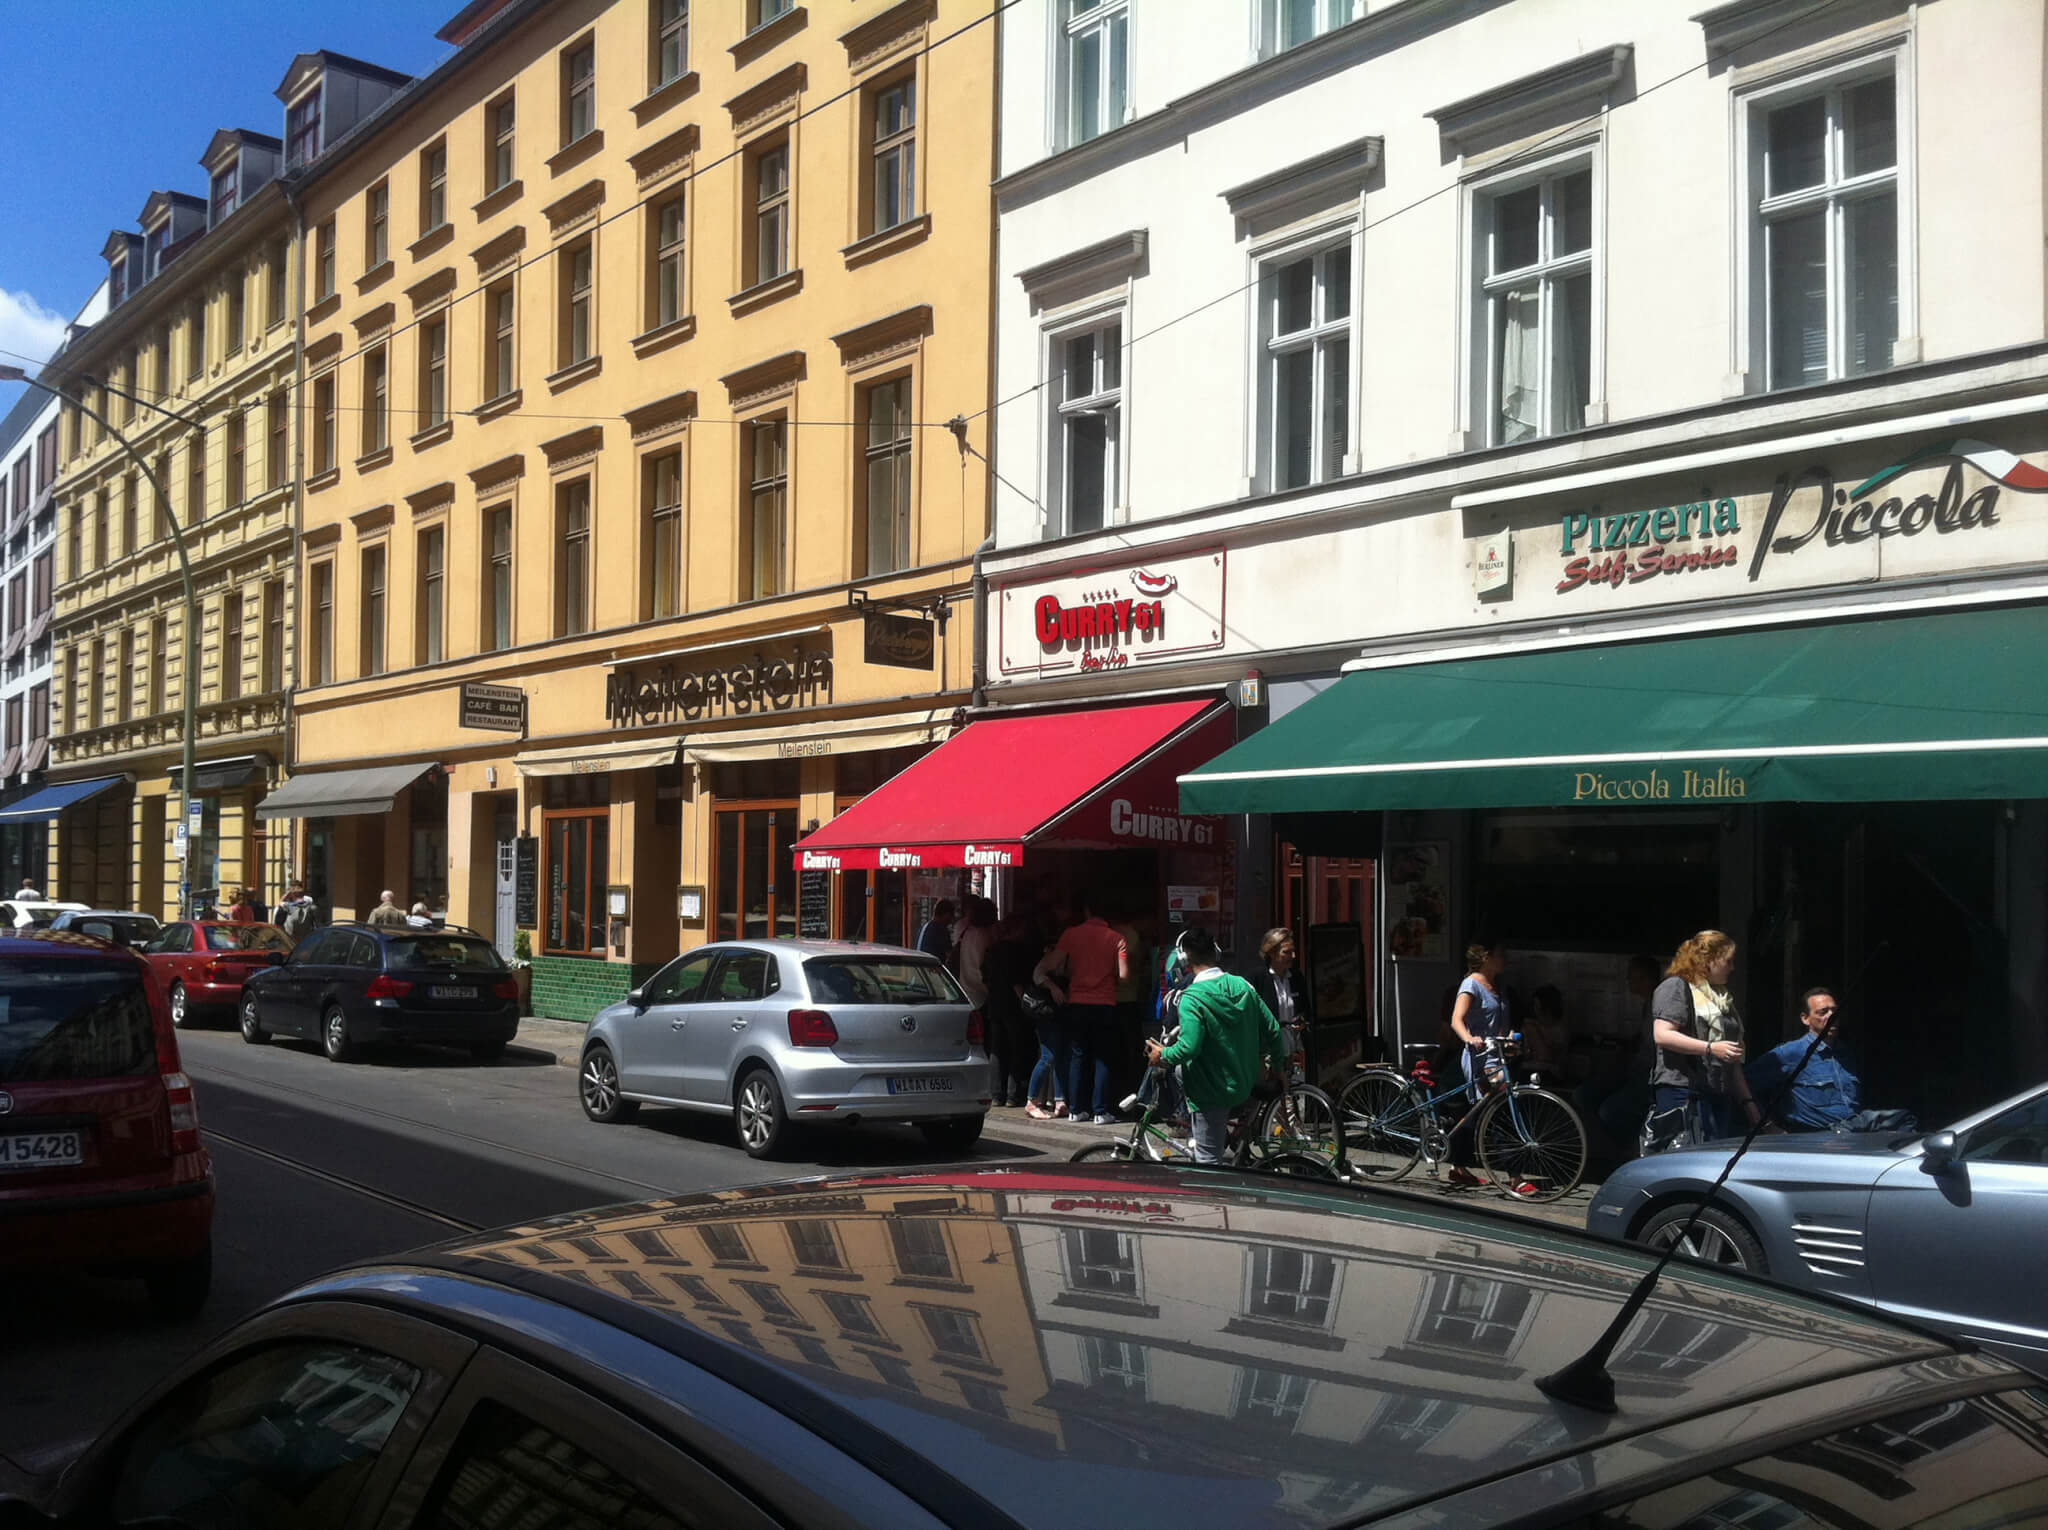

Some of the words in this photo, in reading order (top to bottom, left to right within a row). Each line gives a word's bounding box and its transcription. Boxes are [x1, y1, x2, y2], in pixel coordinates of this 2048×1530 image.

[1560, 496, 1740, 556] Pizzeria
[1748, 455, 2002, 581] Piccola
[1556, 544, 1738, 593] Self-Service
[1080, 647, 1128, 670] Berlin
[468, 687, 519, 699] MEILENSTEIN
[606, 646, 830, 720] Meilenstein
[467, 715, 518, 726] RESTAURANT
[499, 704, 519, 713] BAR
[778, 740, 832, 758] Meilenstein
[571, 760, 611, 773] Meilenstein
[1573, 768, 1670, 800] Piccola
[1681, 767, 1746, 799] Italia
[178, 826, 185, 837] P
[1110, 799, 1192, 842] CURRY
[1194, 824, 1213, 845] 61
[15, 1135, 77, 1160] 5428
